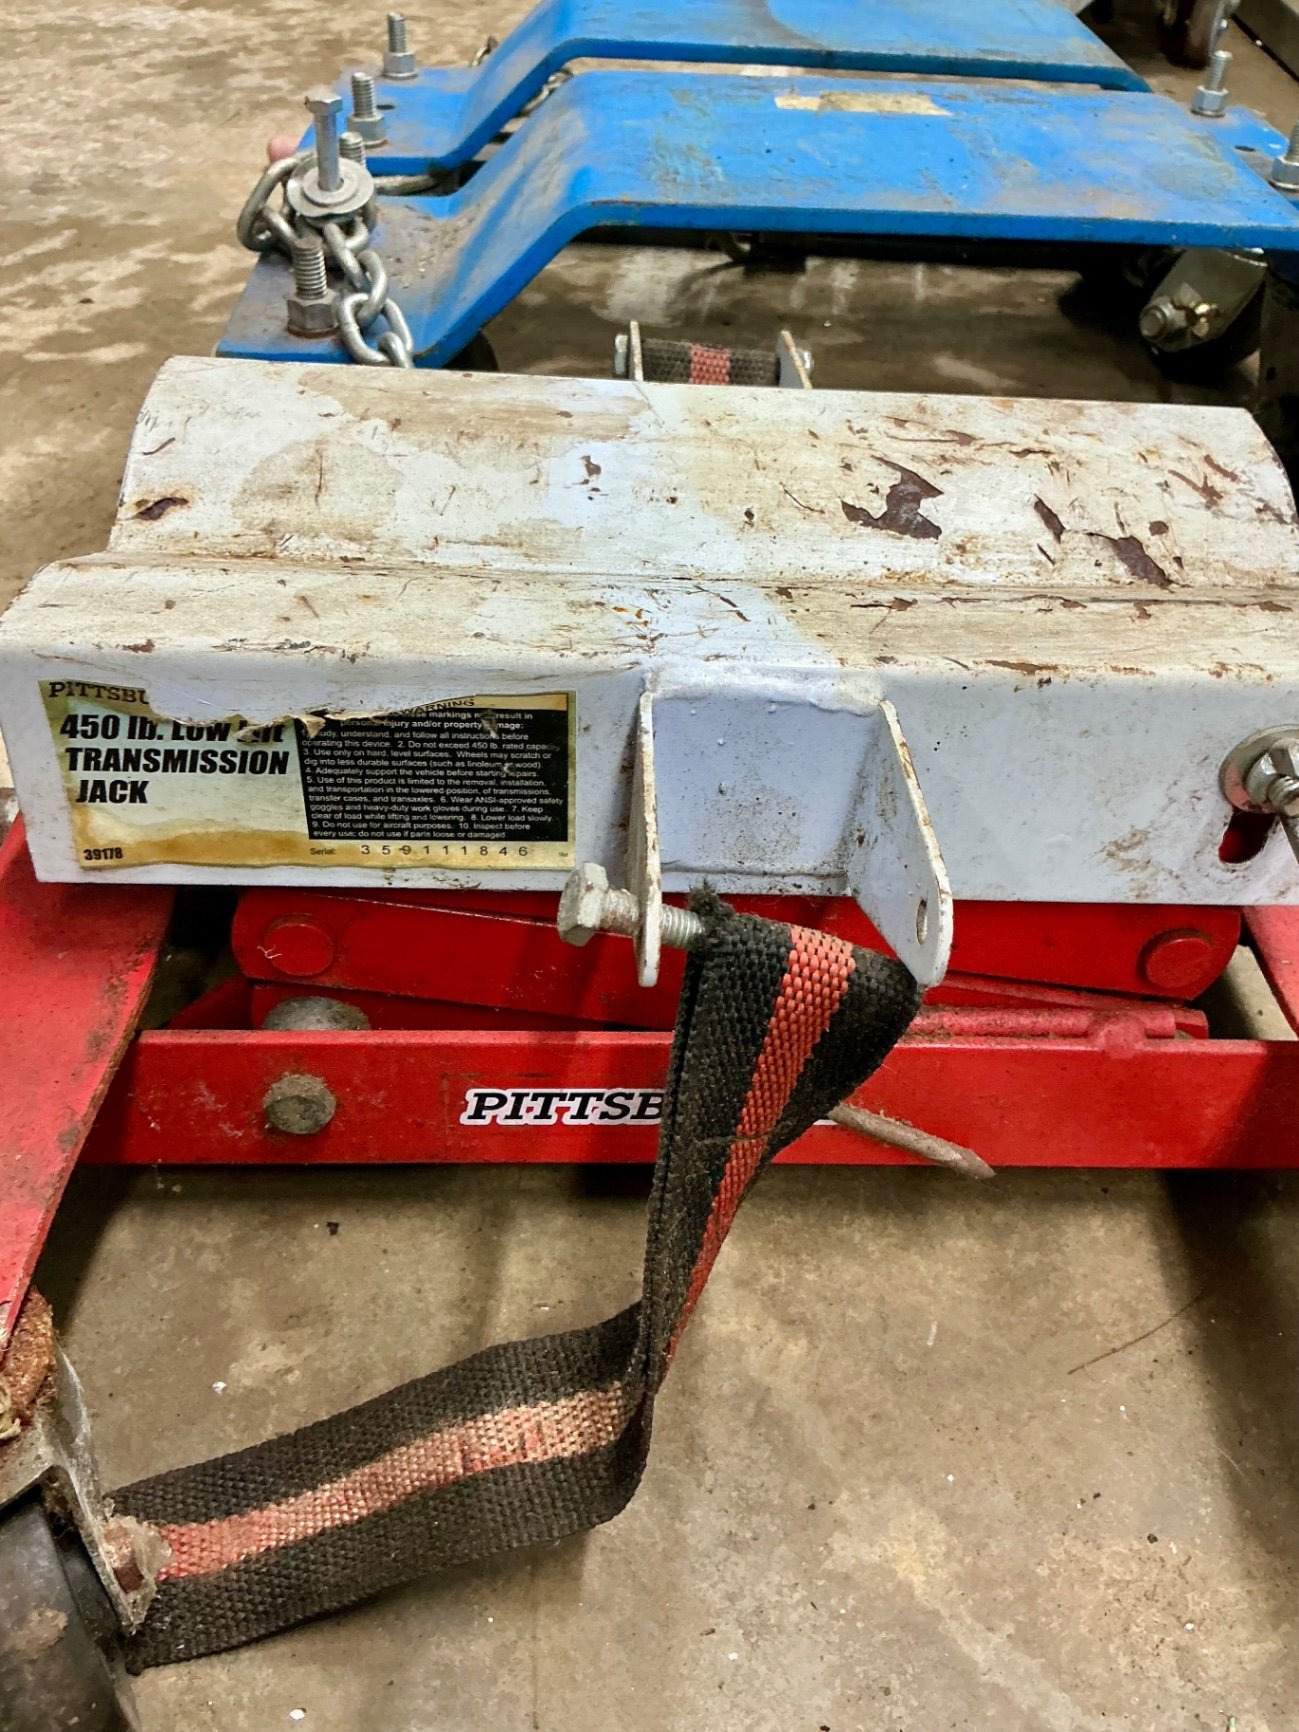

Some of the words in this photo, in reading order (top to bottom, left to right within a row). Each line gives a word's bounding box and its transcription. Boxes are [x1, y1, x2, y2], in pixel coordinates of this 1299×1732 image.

[60, 714, 120, 739] 450
[65, 747, 289, 775] TRANSMISSION
[476, 770, 506, 778] starting
[76, 780, 149, 803] JACK
[475, 797, 536, 805] ANSI-approved
[84, 847, 123, 860] 39178
[466, 1092, 662, 1121] PITTSB
